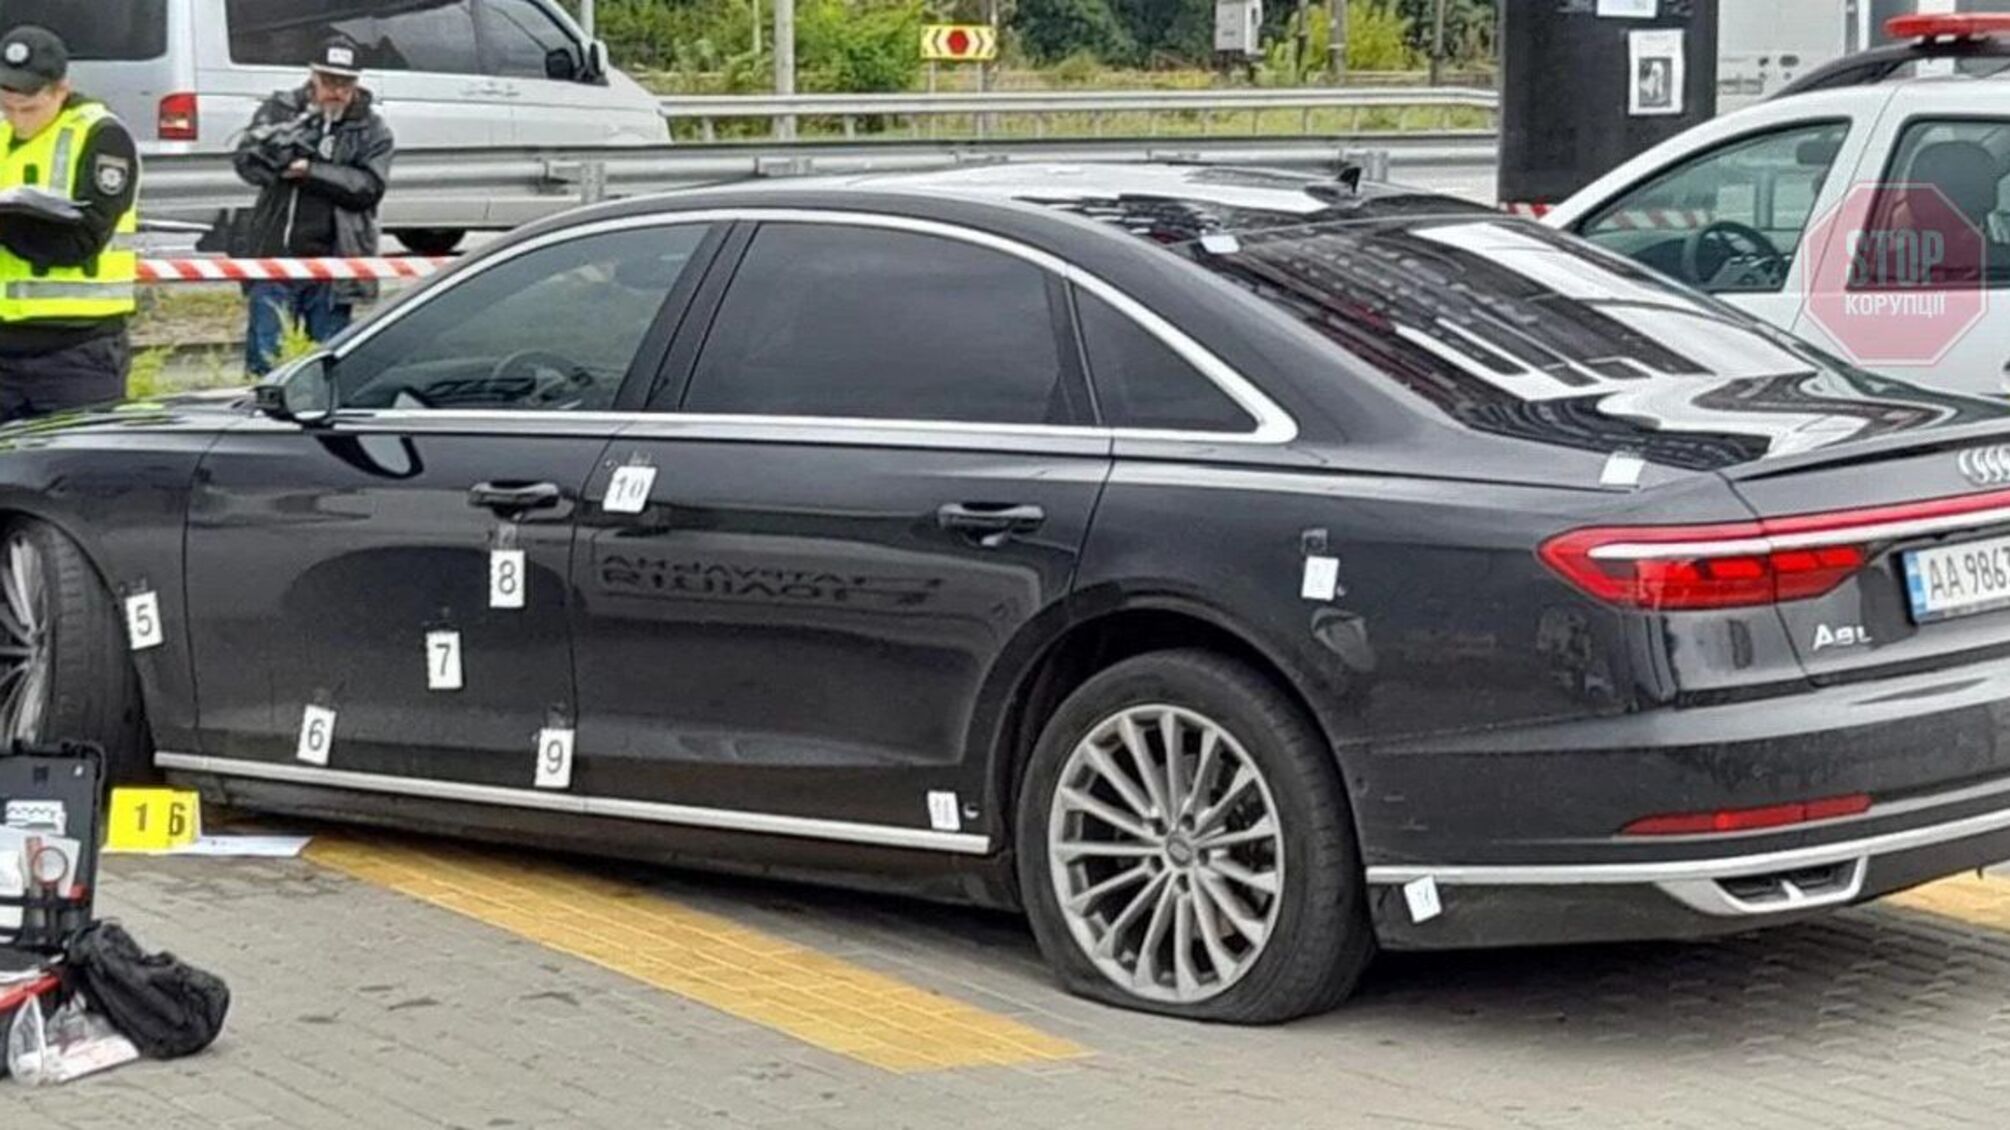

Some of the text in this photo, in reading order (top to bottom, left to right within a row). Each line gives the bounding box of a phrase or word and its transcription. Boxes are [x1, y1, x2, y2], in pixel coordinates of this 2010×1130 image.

[615, 475, 645, 502] 10
[499, 560, 516, 595] 8
[1929, 554, 1965, 600] AA
[136, 603, 152, 637] 5
[435, 643, 451, 677] 7
[307, 718, 325, 752] 6
[546, 739, 564, 774] 9
